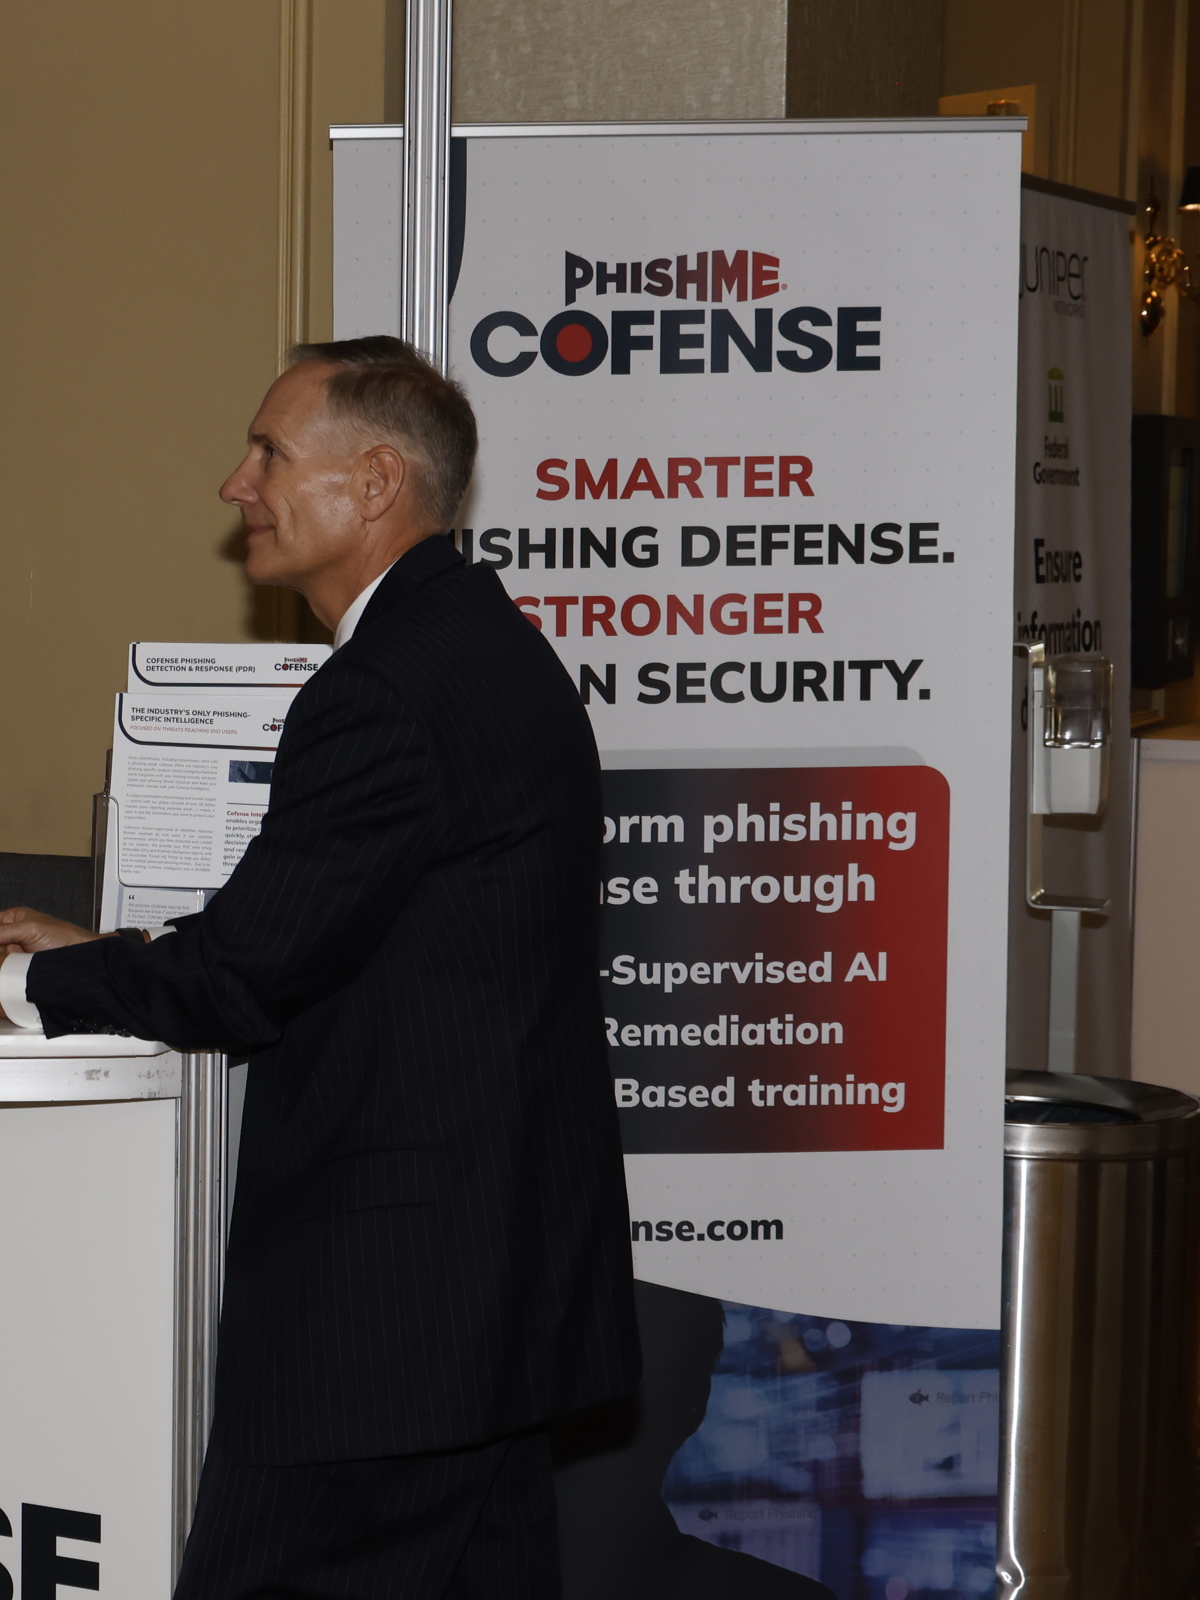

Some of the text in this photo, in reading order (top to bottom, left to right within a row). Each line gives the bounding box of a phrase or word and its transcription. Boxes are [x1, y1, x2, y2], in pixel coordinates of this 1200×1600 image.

[565, 249, 780, 306] PHISHME
[470, 306, 882, 377] COFENSE
[535, 455, 815, 501] SMARTER
[1033, 461, 1080, 486] Government
[449, 522, 955, 570] ISHING DEFENSE.
[1033, 538, 1083, 584] Ensure
[514, 592, 824, 637] STRONGER
[274, 664, 318, 672] COFENSE
[637, 658, 930, 705] SECURITY.
[147, 708, 190, 716] INDUSTRY'S
[703, 802, 917, 853] phishing
[675, 863, 876, 913] through
[600, 951, 888, 993] -Supervised AI
[604, 1014, 843, 1047] Remediation
[614, 1074, 906, 1113] Based training
[631, 1219, 784, 1242] nse.com
